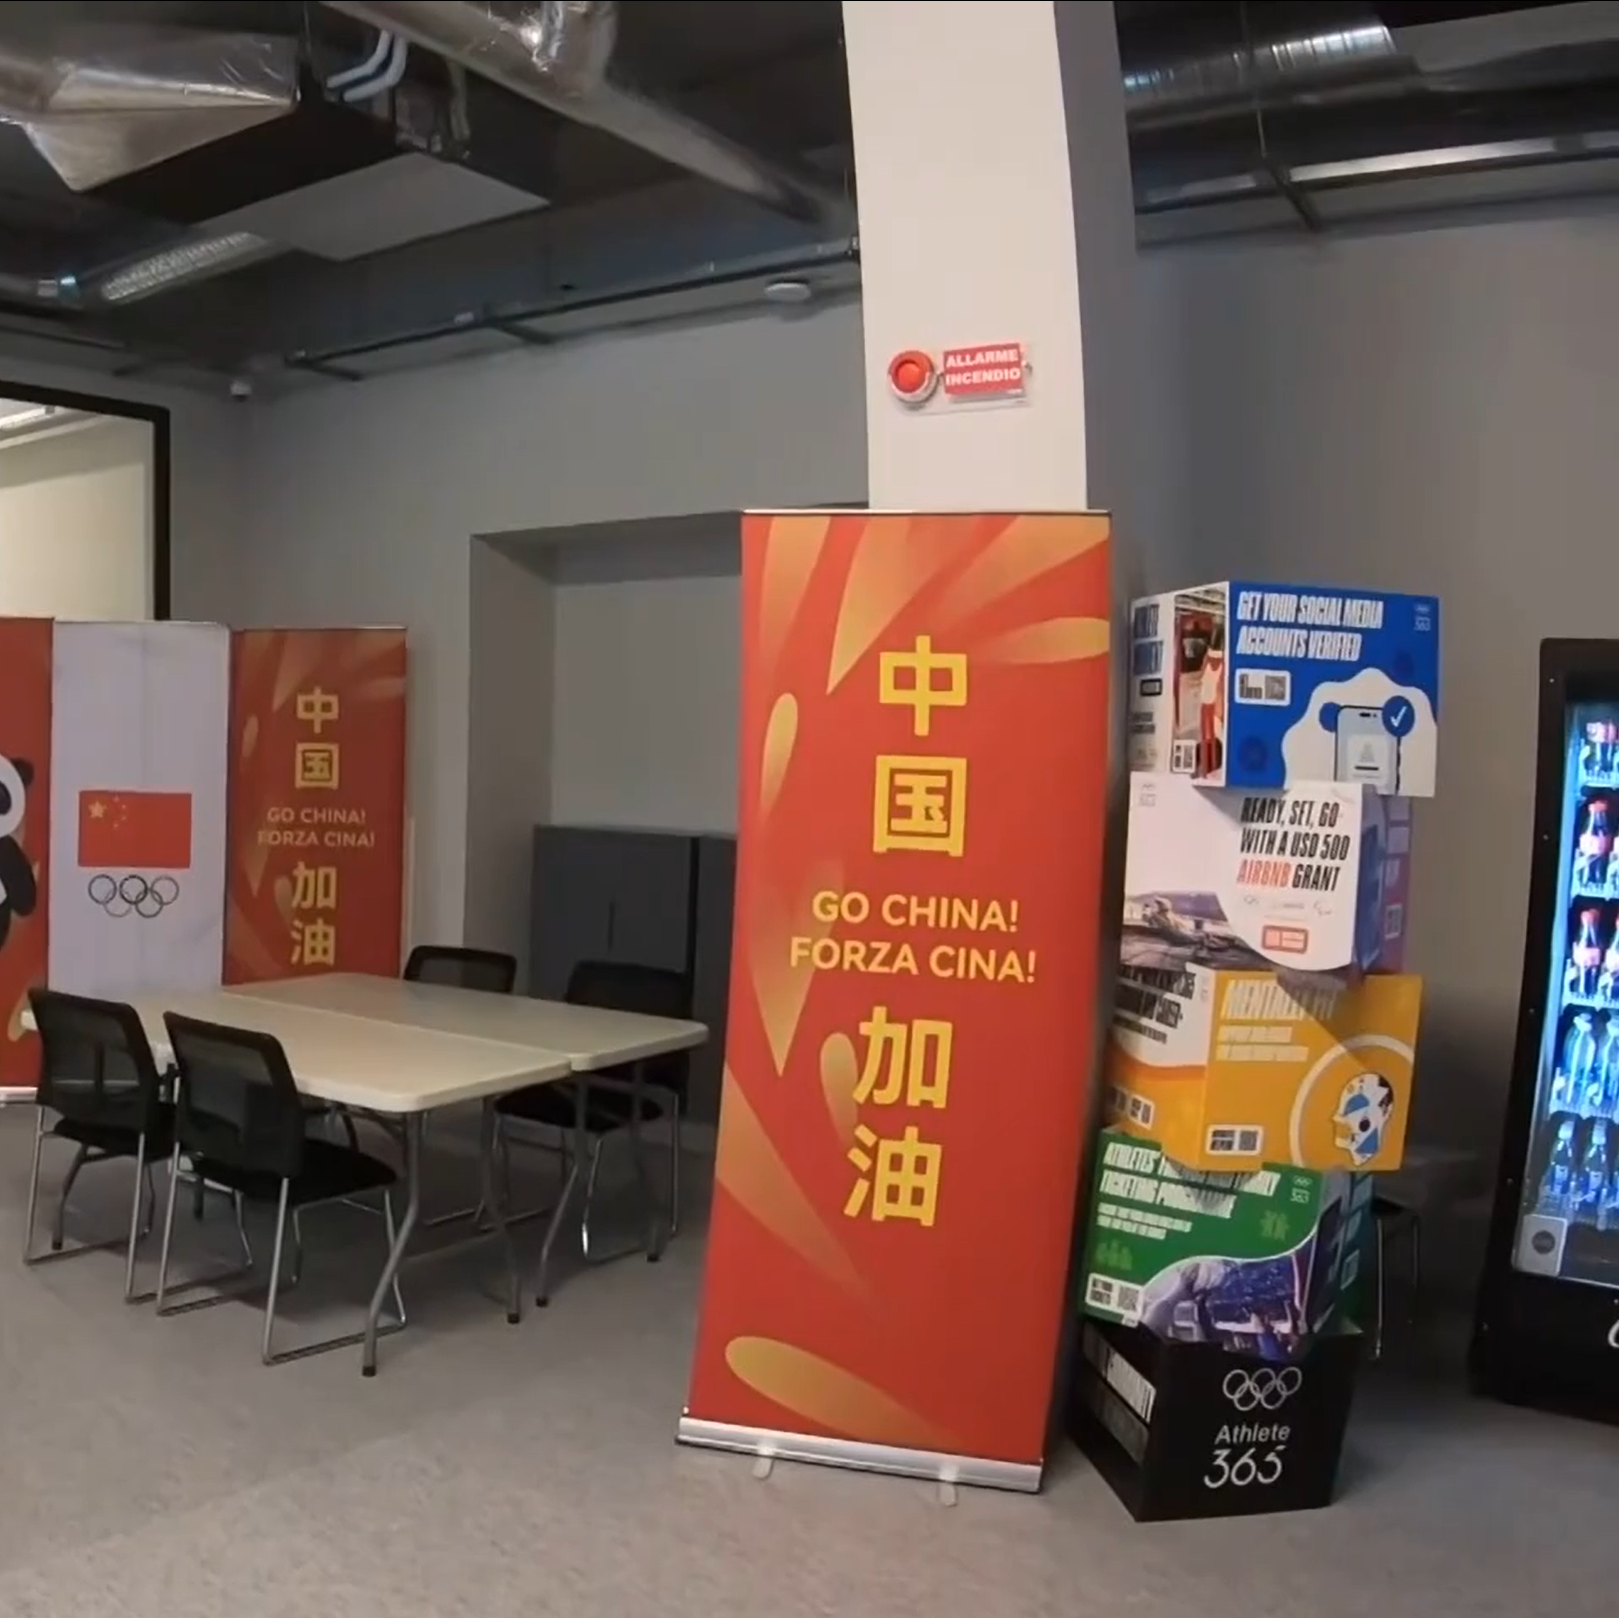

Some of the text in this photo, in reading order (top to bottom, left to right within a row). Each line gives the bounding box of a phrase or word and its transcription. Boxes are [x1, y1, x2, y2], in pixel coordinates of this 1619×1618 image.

[946, 349, 1018, 368] ALLARME
[946, 368, 1020, 386] INCENDIO
[1237, 591, 1263, 621] GET
[1263, 593, 1297, 622] YOUR
[1298, 595, 1343, 626] SOCIAL
[1342, 598, 1384, 630] MEDIA
[1236, 625, 1362, 662] ACCOUNTS VERIFIED
[295, 686, 339, 790] 中国
[873, 635, 967, 857] 中国
[267, 807, 366, 824] GO CHINA!
[1240, 797, 1340, 828] READY, SET, GO
[257, 830, 375, 848] FORZA CINA!
[1240, 828, 1351, 861] WITH A USD 500
[1236, 859, 1341, 892] AIRBNB GRANT
[291, 861, 337, 966] 加油
[813, 890, 1020, 932] GO CHINA!
[789, 938, 1036, 983] FORZA CINA!
[844, 1006, 953, 1227] 加油
[1214, 1422, 1291, 1445] Athlete
[1204, 1446, 1287, 1489] 365
